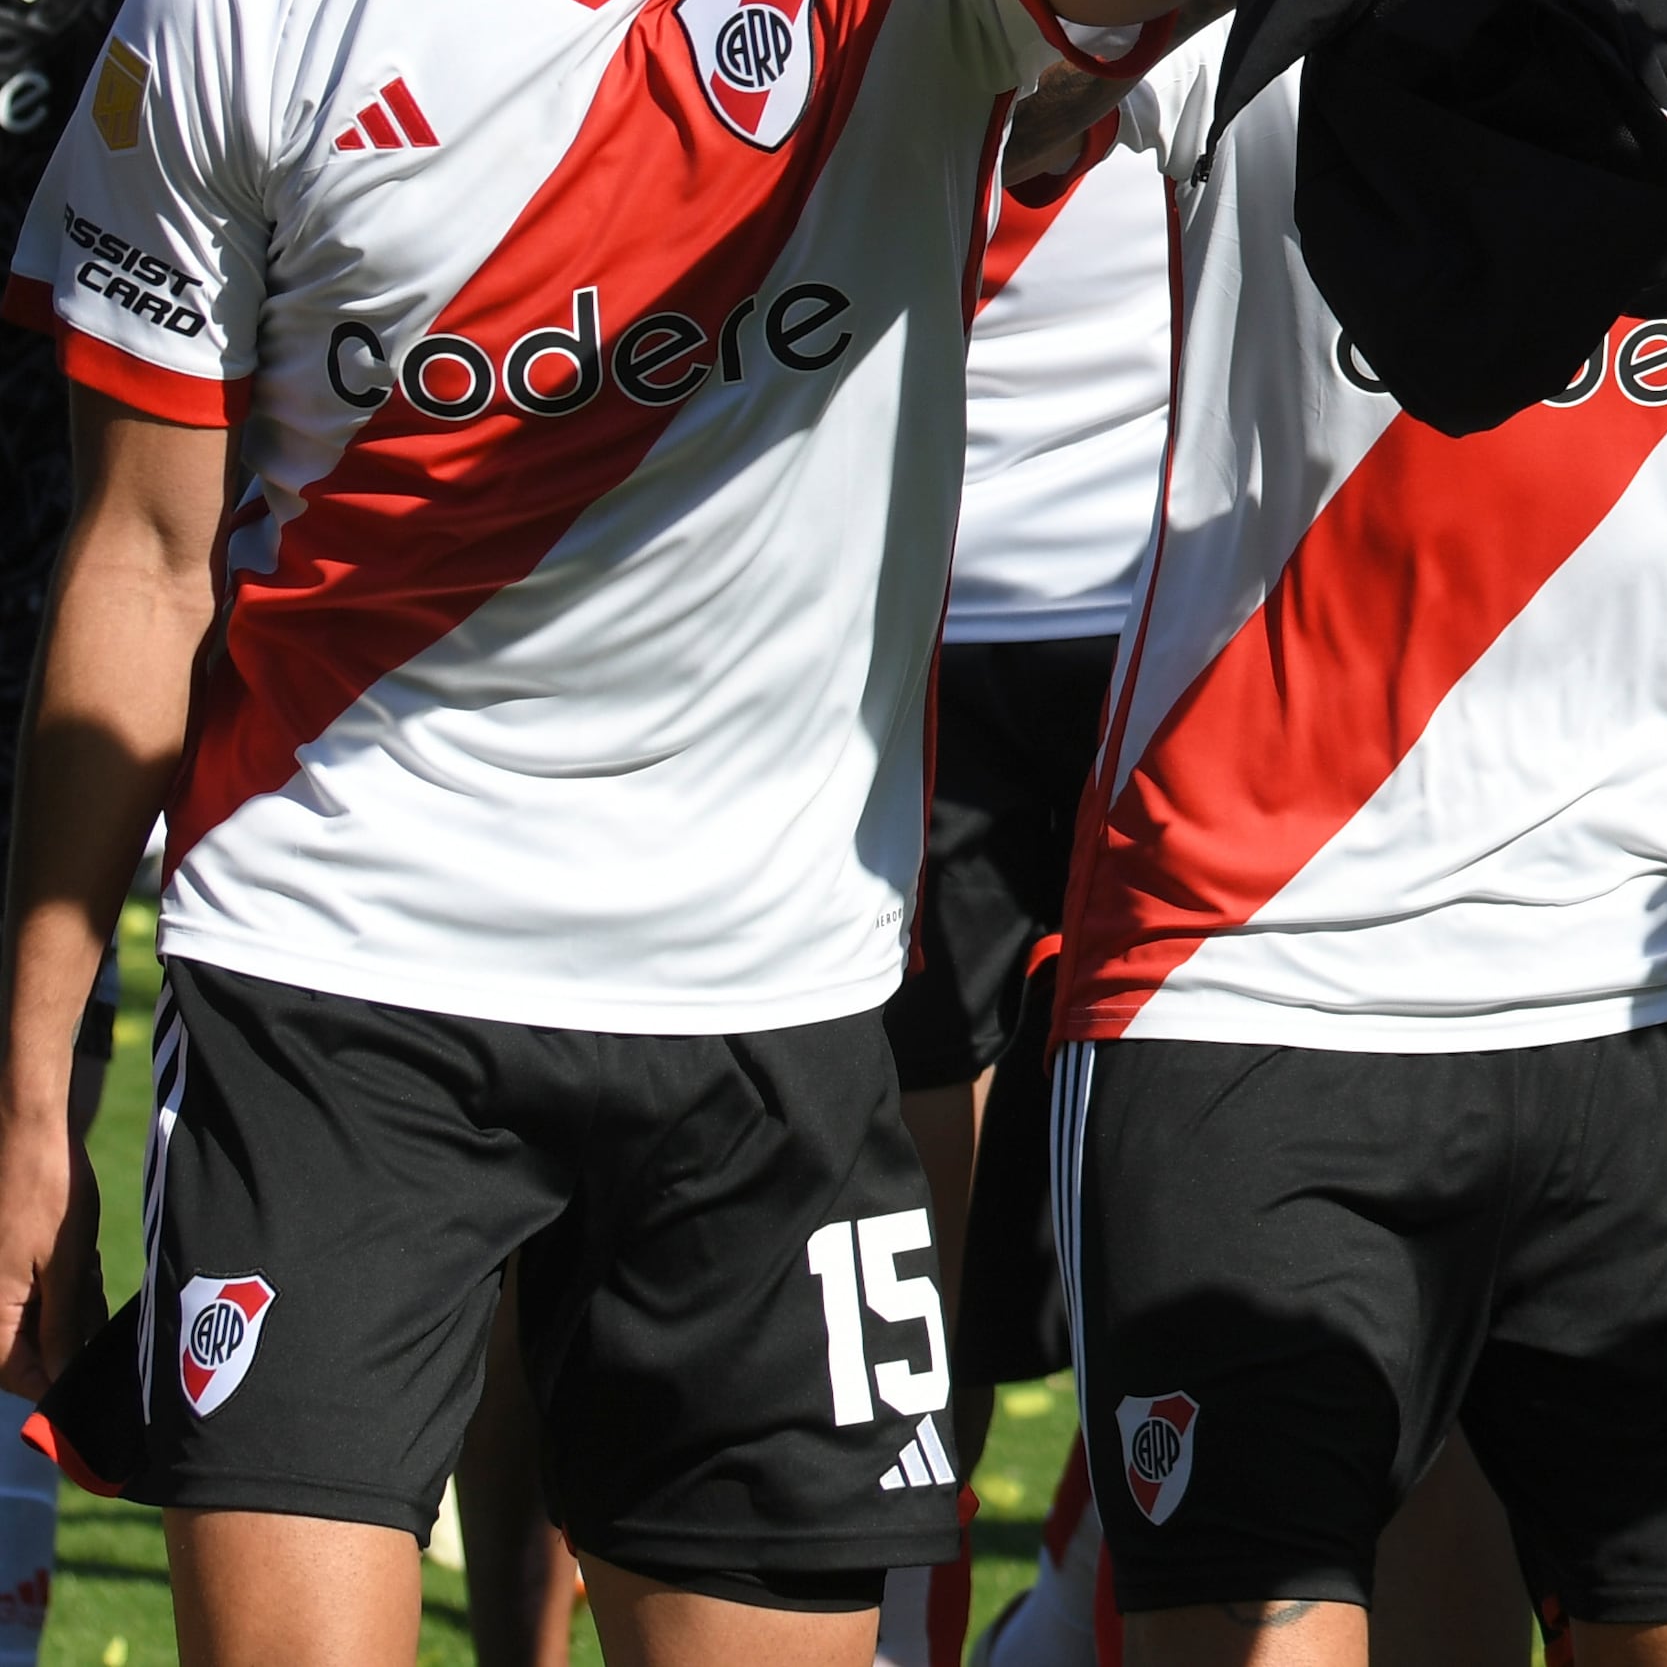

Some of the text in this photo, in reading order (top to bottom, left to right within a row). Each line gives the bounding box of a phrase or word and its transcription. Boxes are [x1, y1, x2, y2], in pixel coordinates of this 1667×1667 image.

[76, 260, 207, 339] CARD
[326, 285, 853, 421] codere
[806, 1206, 951, 1427] 15
